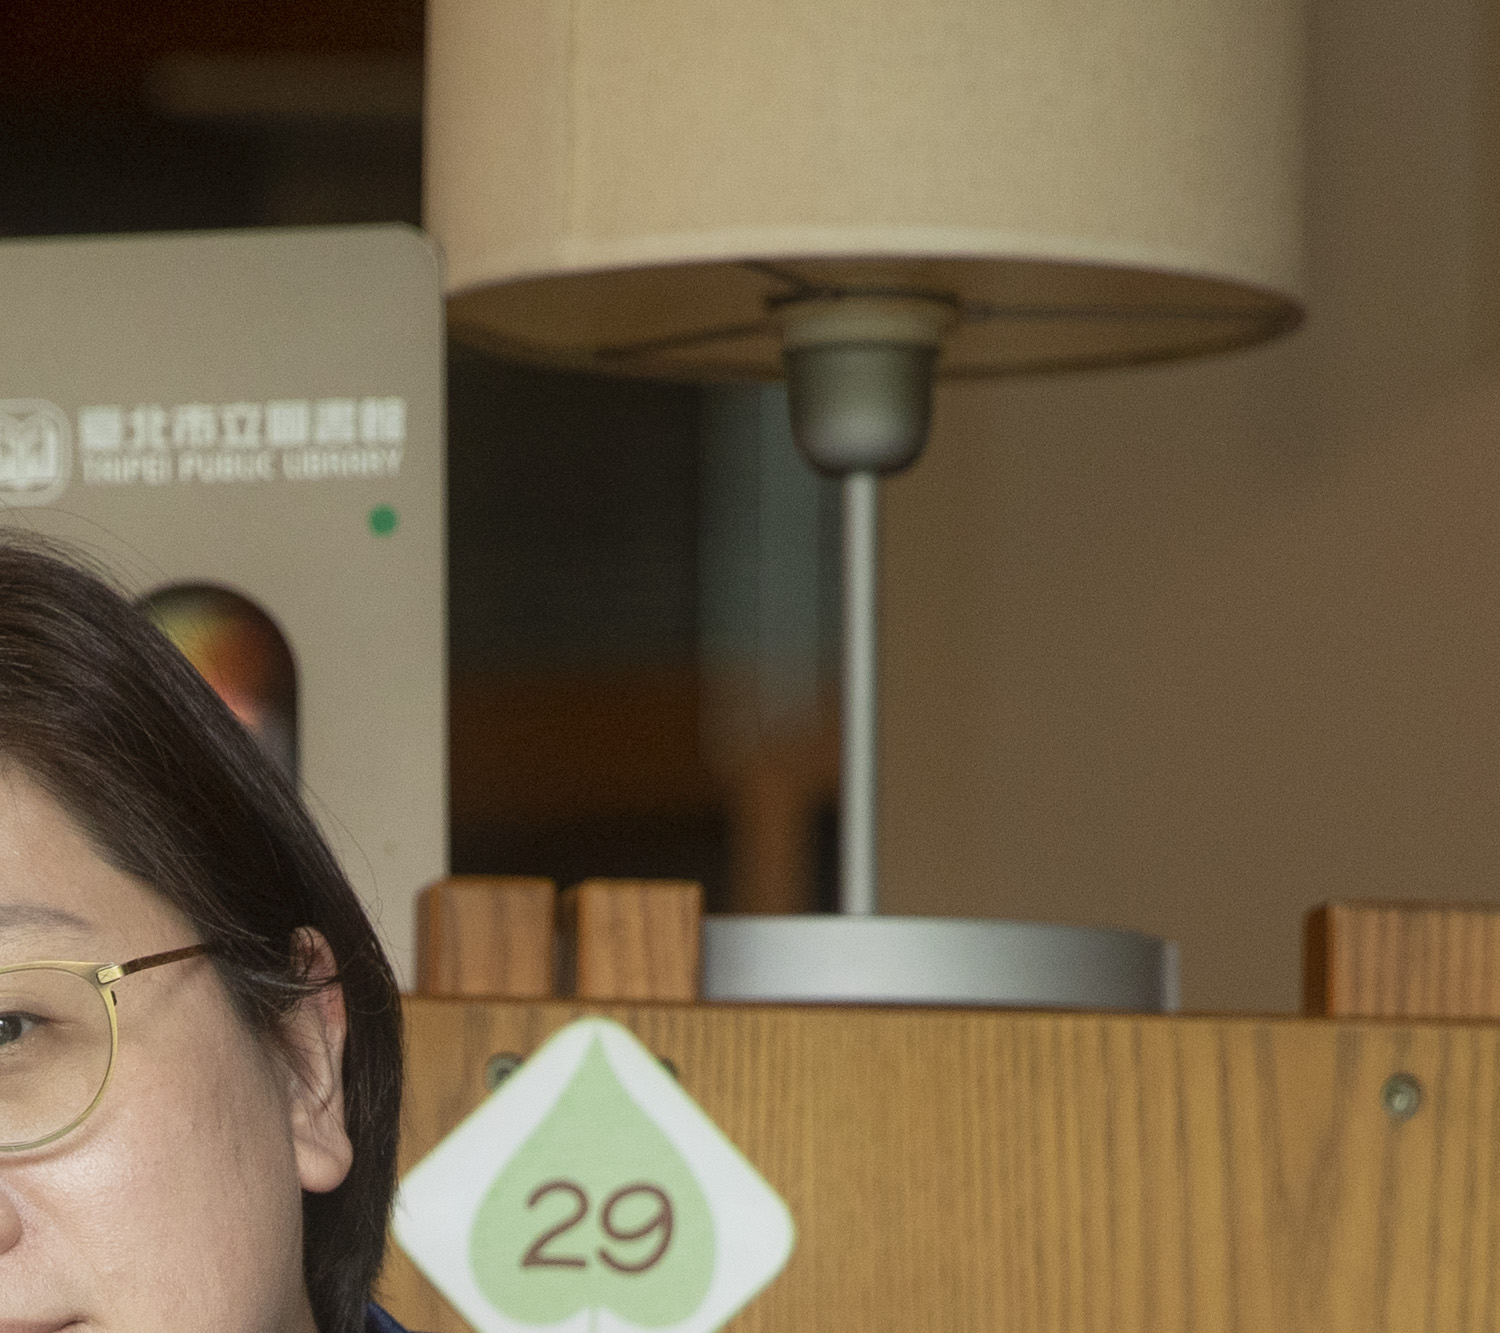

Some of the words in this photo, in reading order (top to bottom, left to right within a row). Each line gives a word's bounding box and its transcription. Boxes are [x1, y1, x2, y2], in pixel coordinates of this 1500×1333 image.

[81, 451, 171, 485] TAIPEI
[178, 450, 274, 484] PUBLIC
[282, 447, 402, 481] LIBRARY
[521, 1177, 677, 1274] 29
